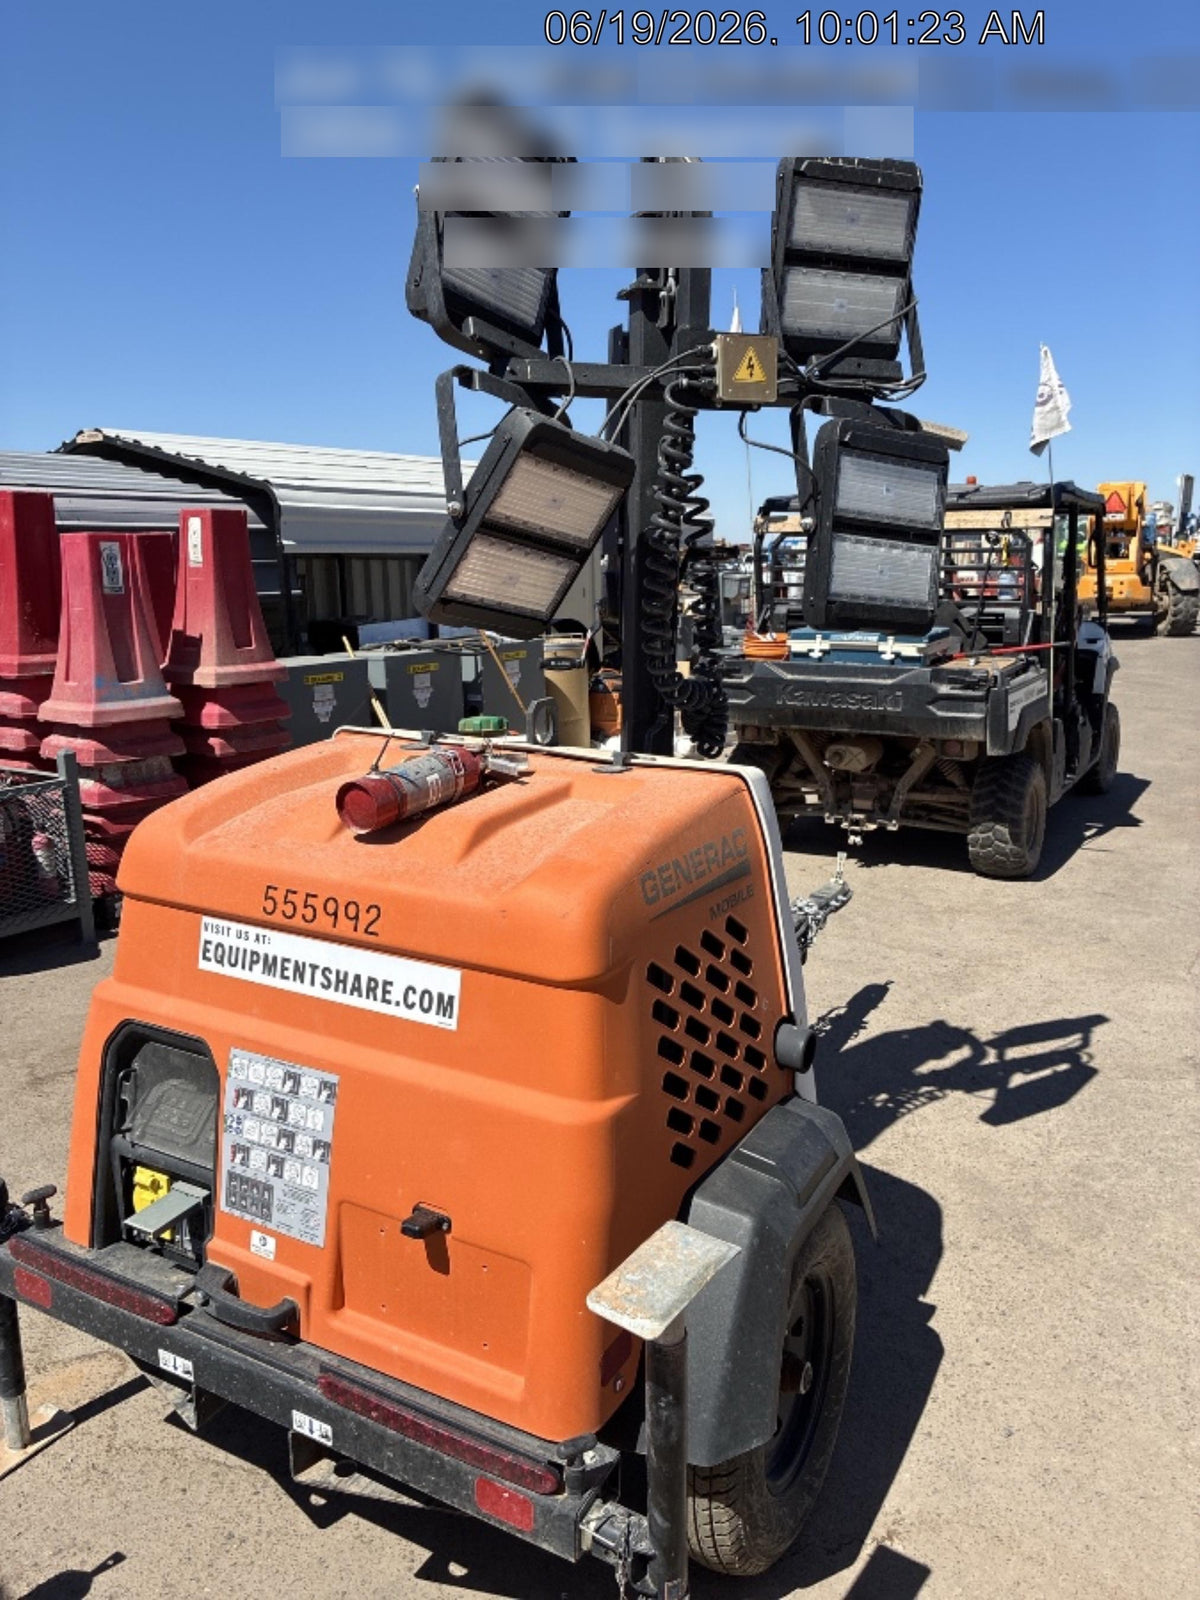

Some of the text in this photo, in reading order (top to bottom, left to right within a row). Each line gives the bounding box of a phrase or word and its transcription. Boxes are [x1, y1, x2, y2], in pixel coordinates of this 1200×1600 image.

[776, 684, 903, 712] Kawasaki
[639, 827, 748, 906] GENERAC
[262, 884, 382, 937] 555992
[708, 883, 755, 921] MOBILE
[203, 921, 272, 946] VISIT US AT:
[201, 939, 456, 1020] EQUIPMENTSHARE.COM
